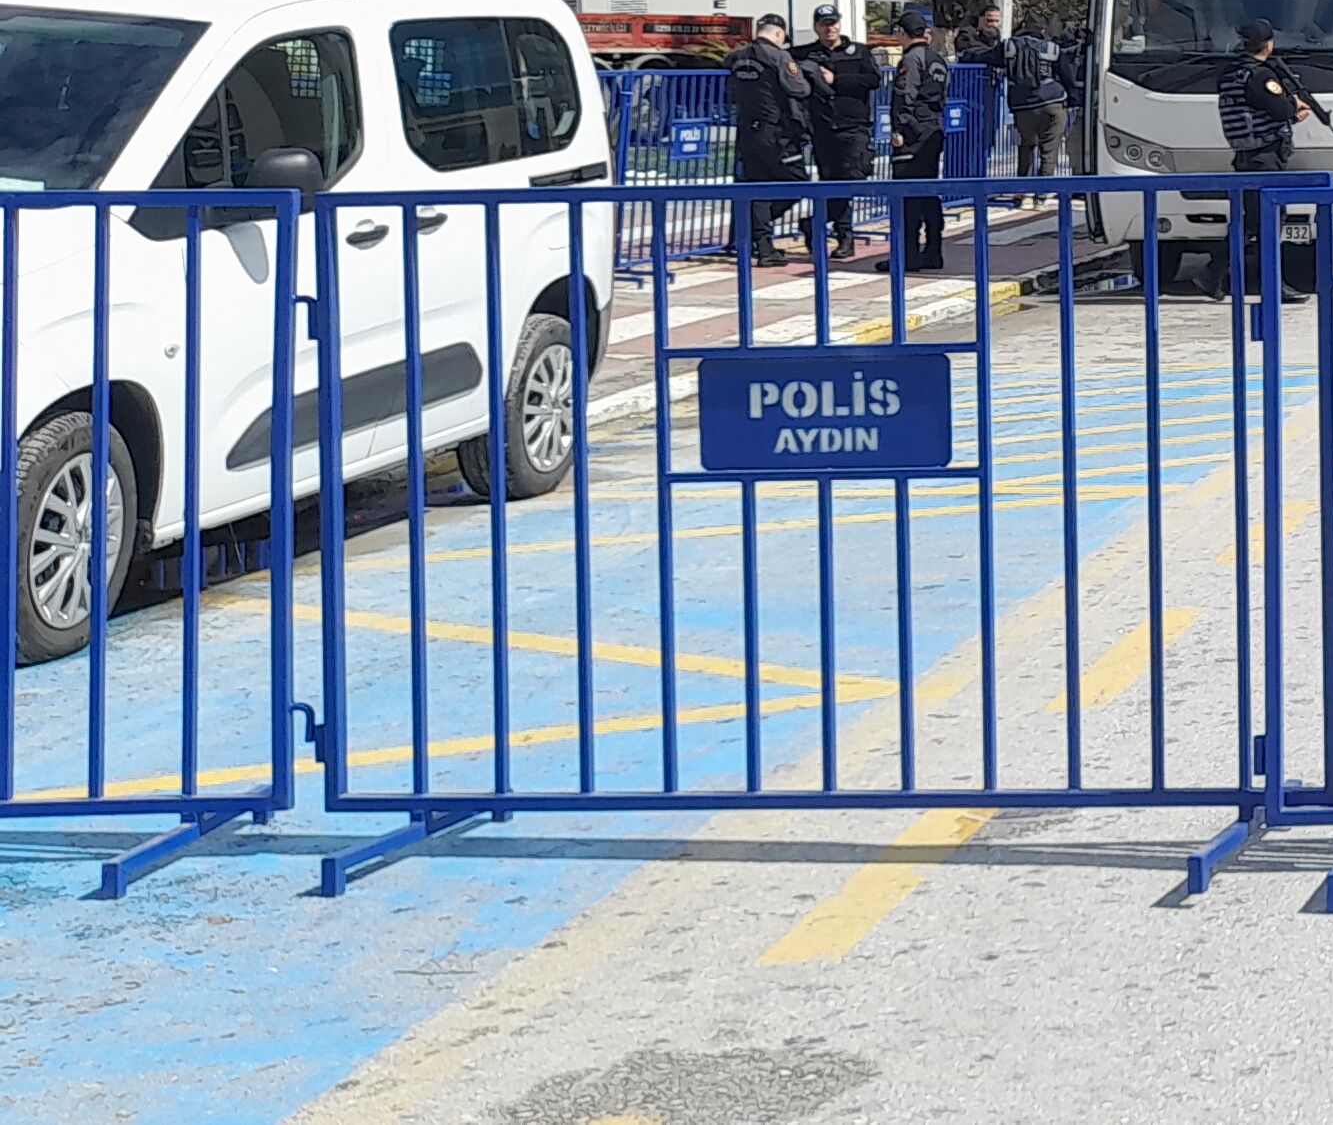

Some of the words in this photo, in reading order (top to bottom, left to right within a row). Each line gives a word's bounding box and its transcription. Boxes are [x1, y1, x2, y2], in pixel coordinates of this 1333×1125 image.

[1285, 226, 1308, 239] 932
[749, 370, 901, 419] POLİS
[773, 427, 879, 454] AYDIN
